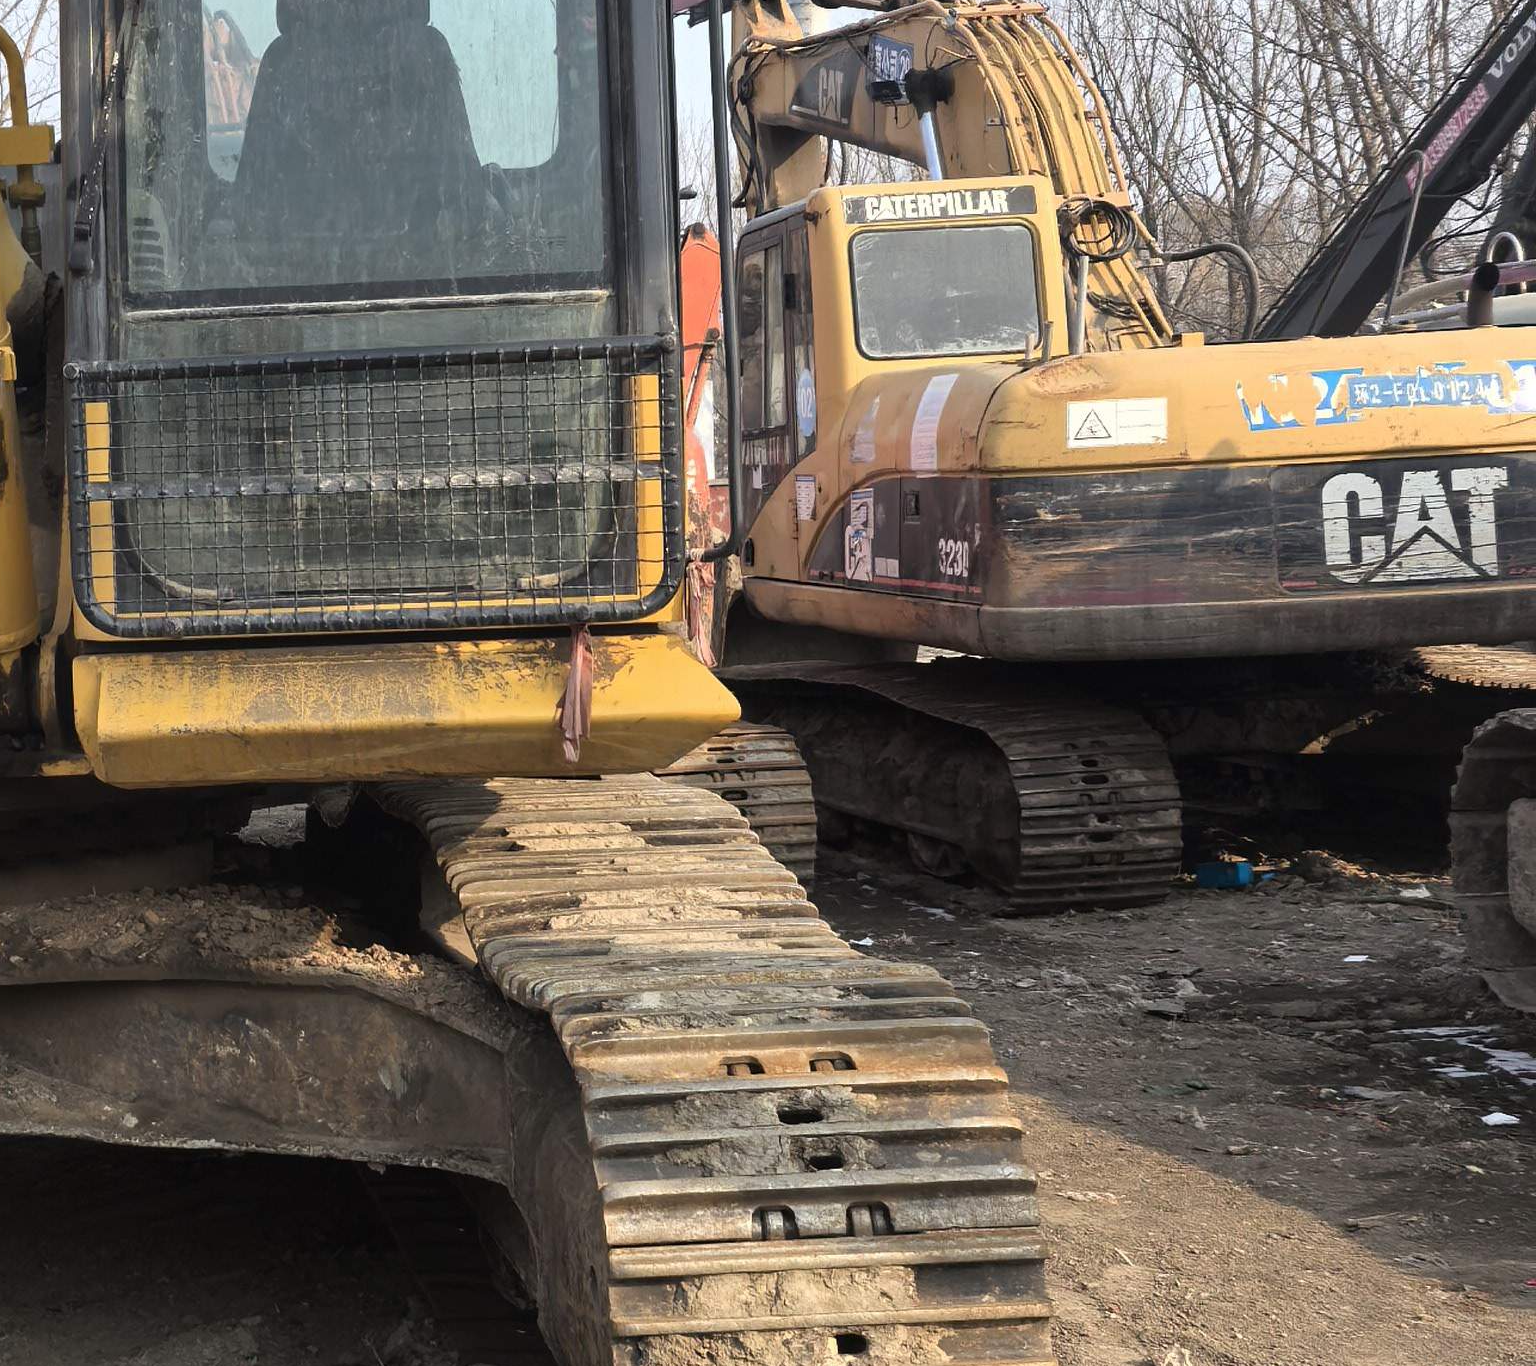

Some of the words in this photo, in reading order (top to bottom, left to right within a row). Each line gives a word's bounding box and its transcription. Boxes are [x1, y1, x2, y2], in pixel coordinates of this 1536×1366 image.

[818, 66, 844, 123] CAT
[865, 189, 1009, 221] CATERPILLAR
[1321, 466, 1509, 584] CAT
